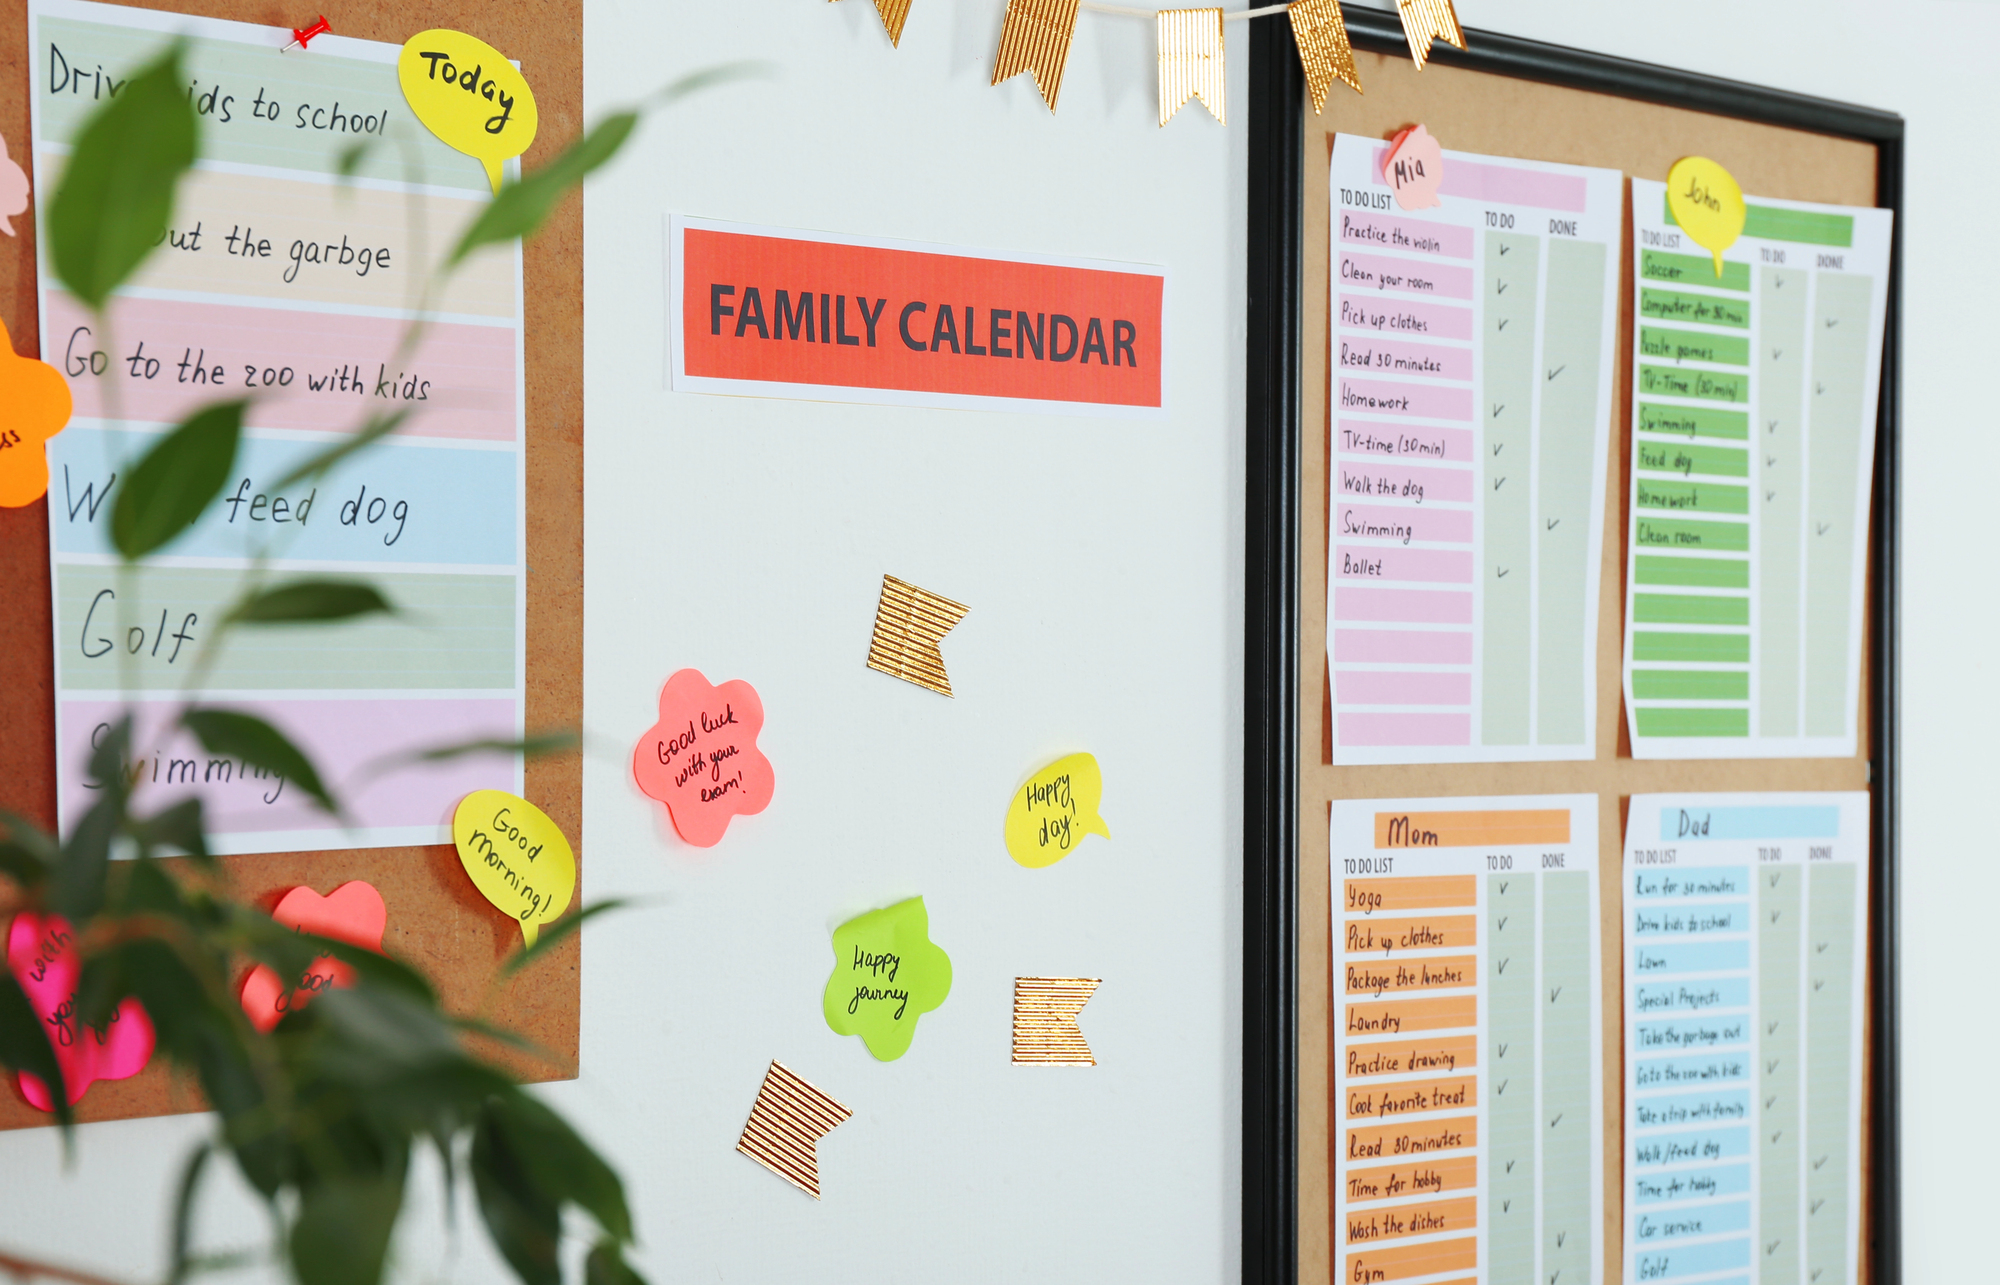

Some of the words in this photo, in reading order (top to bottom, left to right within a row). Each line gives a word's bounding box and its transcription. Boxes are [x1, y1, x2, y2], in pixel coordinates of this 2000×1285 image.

[50, 42, 138, 101] Driv
[187, 78, 235, 123] ids
[252, 87, 281, 121] to
[296, 109, 389, 137] school
[419, 51, 515, 135] Today
[1394, 157, 1425, 189] Mia
[1340, 188, 1353, 205] TO
[1354, 190, 1369, 207] DO
[1371, 192, 1391, 210] LIST
[1684, 176, 1721, 213] John
[1343, 214, 1387, 243] Practice
[1392, 227, 1410, 246] the
[1413, 234, 1440, 252] violin
[1485, 211, 1498, 226] TO
[1500, 213, 1515, 229] DO
[1549, 218, 1578, 236] DONE
[225, 225, 272, 257] the
[283, 234, 391, 285] garbge
[1663, 233, 1680, 248] LIST
[1341, 258, 1373, 281] Clean
[1380, 274, 1403, 290] your
[1407, 278, 1434, 291] room
[1644, 254, 1683, 279] Soccer
[1817, 253, 1844, 269] DONE
[710, 283, 887, 347] FAMILY
[899, 301, 1138, 368] CALENDAR
[1341, 301, 1366, 325] Pick
[1371, 313, 1385, 330] up
[1390, 314, 1428, 332] clothes
[65, 327, 108, 378] Go
[126, 342, 161, 379] to
[177, 347, 225, 387] the
[308, 364, 365, 395] with
[375, 363, 431, 401] kids
[1341, 342, 1371, 367] Read
[1377, 353, 1391, 369] 30
[1395, 356, 1442, 373] minutes
[1342, 382, 1409, 411] Homework
[1639, 406, 1696, 439] Swimming
[1344, 430, 1394, 454] TV-time
[1640, 447, 1666, 467] Feed
[1674, 452, 1692, 476] dog
[1343, 470, 1371, 494] Walk
[1378, 478, 1397, 495] the
[1402, 479, 1424, 504] dog
[1638, 483, 1698, 508] Homework
[226, 478, 317, 527] feed
[340, 485, 409, 546] dog
[1344, 510, 1412, 545] Swimming
[1343, 553, 1382, 576] Ballet
[80, 589, 197, 663] Golf
[657, 720, 697, 765] Good
[701, 703, 739, 733] luck
[674, 752, 706, 788] with
[710, 745, 739, 782] your
[700, 770, 746, 802] exam!
[1026, 773, 1070, 812] Happy
[492, 807, 544, 864] Good
[1038, 799, 1079, 849] day!
[1388, 815, 1438, 847] Mom
[1678, 809, 1711, 838] Dad
[1344, 858, 1356, 874] TO
[1358, 858, 1372, 874] DO
[1374, 857, 1393, 874] LIST
[1487, 855, 1498, 870] TO
[1500, 855, 1513, 870] DO
[1542, 853, 1565, 868] DONE
[1660, 849, 1677, 864] LIST
[1809, 846, 1833, 860] DONE
[1348, 924, 1373, 952] Pick
[1381, 937, 1393, 957] up
[1401, 926, 1443, 948] clothes
[853, 944, 900, 983] Happy
[1347, 966, 1390, 998] Package
[1396, 965, 1415, 987] the
[1421, 964, 1462, 985] lunches
[1348, 1051, 1399, 1075] Practice
[1408, 1050, 1455, 1071] drawing
[1349, 1092, 1372, 1115] Cook
[1432, 1084, 1465, 1106] treat
[1350, 1133, 1382, 1159] Read
[1394, 1135, 1409, 1154] 30
[1411, 1130, 1462, 1153] minutes
[1348, 1179, 1378, 1197] Time
[1385, 1173, 1406, 1197] for
[1412, 1170, 1442, 1193] hobby
[1349, 1217, 1378, 1242] Wash
[1383, 1214, 1404, 1234] the
[1410, 1212, 1445, 1232] dishes
[1354, 1260, 1384, 1285] Gym
[1641, 1256, 1669, 1280] Golf
